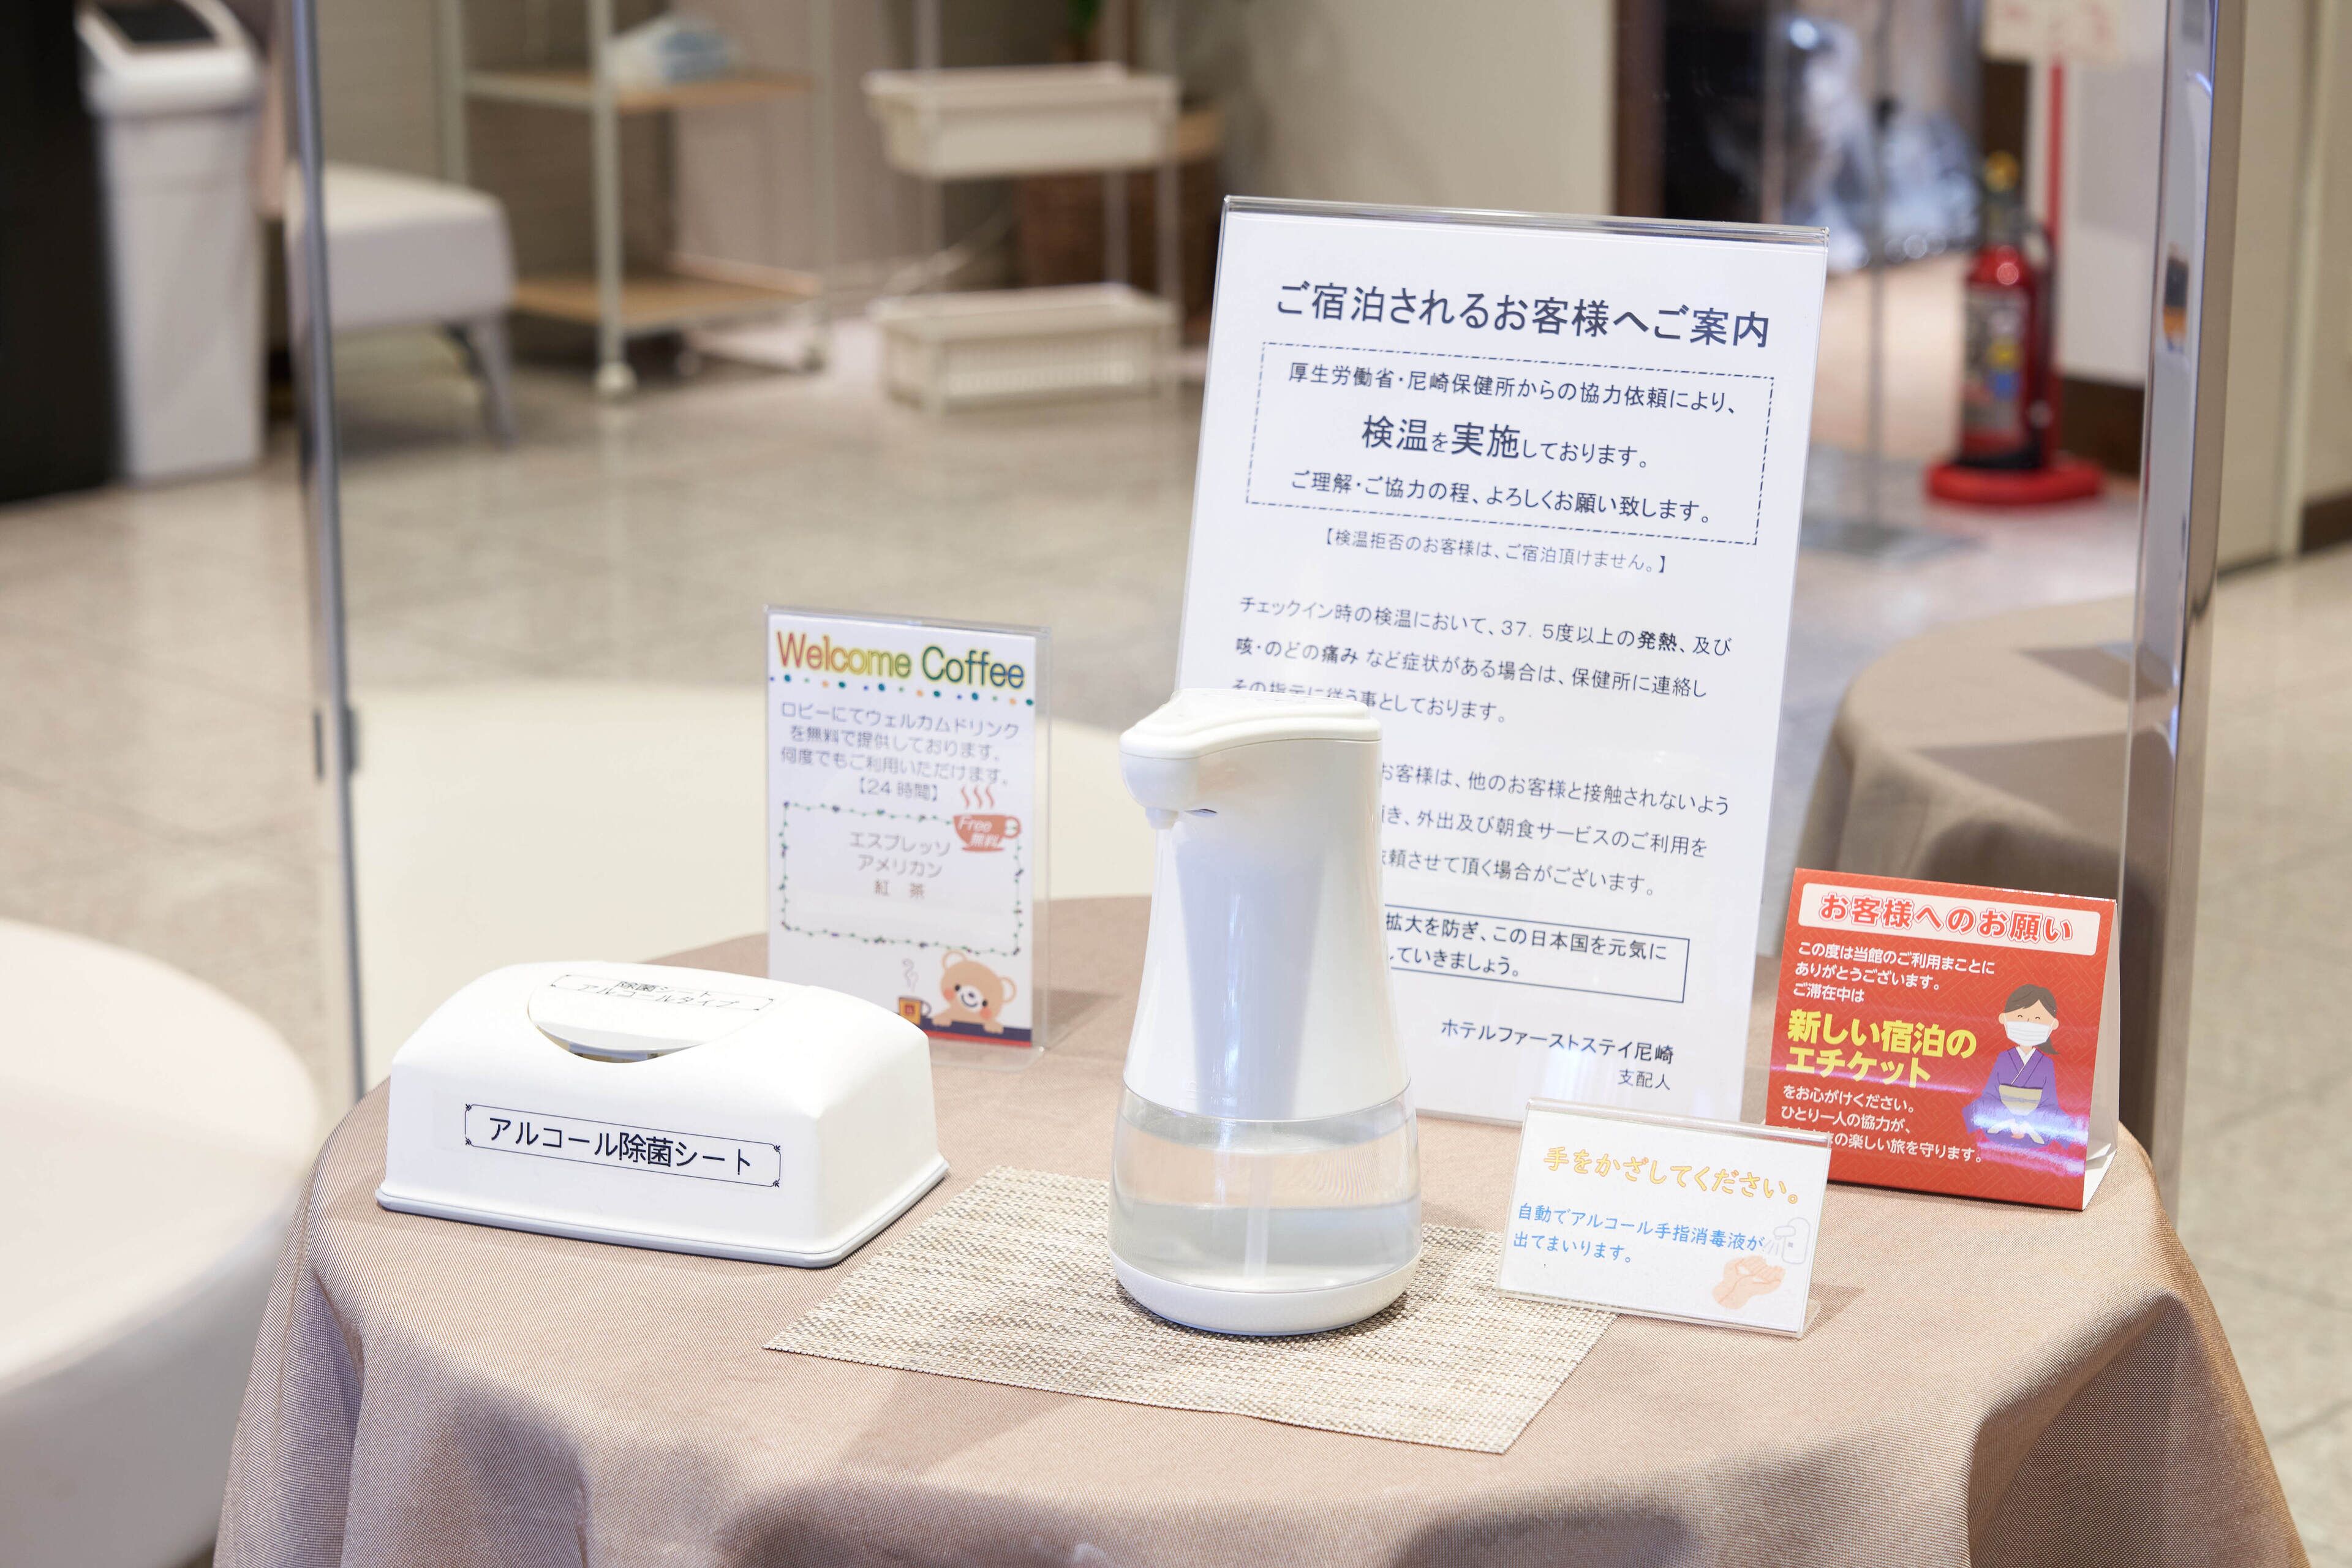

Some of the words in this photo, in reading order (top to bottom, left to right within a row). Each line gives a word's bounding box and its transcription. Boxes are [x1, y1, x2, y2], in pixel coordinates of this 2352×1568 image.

[1277, 281, 1769, 348] ご宿泊されるお客様へご案内
[1288, 362, 1736, 414] 厚生労働省・尼崎保健所からの協力依頼により、
[1362, 415, 1648, 469] 検温を実施しております。
[1291, 469, 1710, 524] ご理解・ご協力の程、よろしくお願い致します。
[1325, 527, 1667, 575] 【検温拒否のお客様は、ご宿泊頂けません。】
[777, 630, 912, 677] Welcome
[922, 646, 1024, 689] Coffee
[782, 702, 1019, 739] ロビーにてウェルカムドリンク
[790, 725, 1000, 761] を無料で提供しております。
[780, 747, 1008, 785] 何度でもご利用いただけます。
[959, 815, 992, 833] Free
[1381, 805, 1706, 857] き、外出及び朝食サービスのご利用を
[850, 832, 950, 856] エスプレッソ
[858, 854, 942, 878] アメリカン
[1819, 892, 2073, 942] お客様へのお願い
[1390, 947, 1519, 977] ていきましょう。
[1795, 962, 1940, 990] ありがとうございます。
[1799, 942, 1995, 974] この度は当館のご利用まことに
[1793, 982, 1864, 1003] ご滞在中は
[1441, 1019, 1673, 1065] ホテルファーストステイ尼崎
[1787, 1008, 1977, 1058] 新しい宿泊の
[1618, 1069, 1670, 1090] 支配人
[1785, 1047, 1931, 1088] エチケット
[1783, 1085, 1914, 1112] をお心がけください。
[1781, 1106, 1911, 1133] ひとり一人の協力が、
[490, 1118, 751, 1175] アルコール除菌シート
[1544, 1147, 1798, 1205] 手をかざしてください。
[1518, 1204, 1764, 1251] 自動でアルコール手指消毒液が
[1513, 1232, 1631, 1263] 出てまいります。
